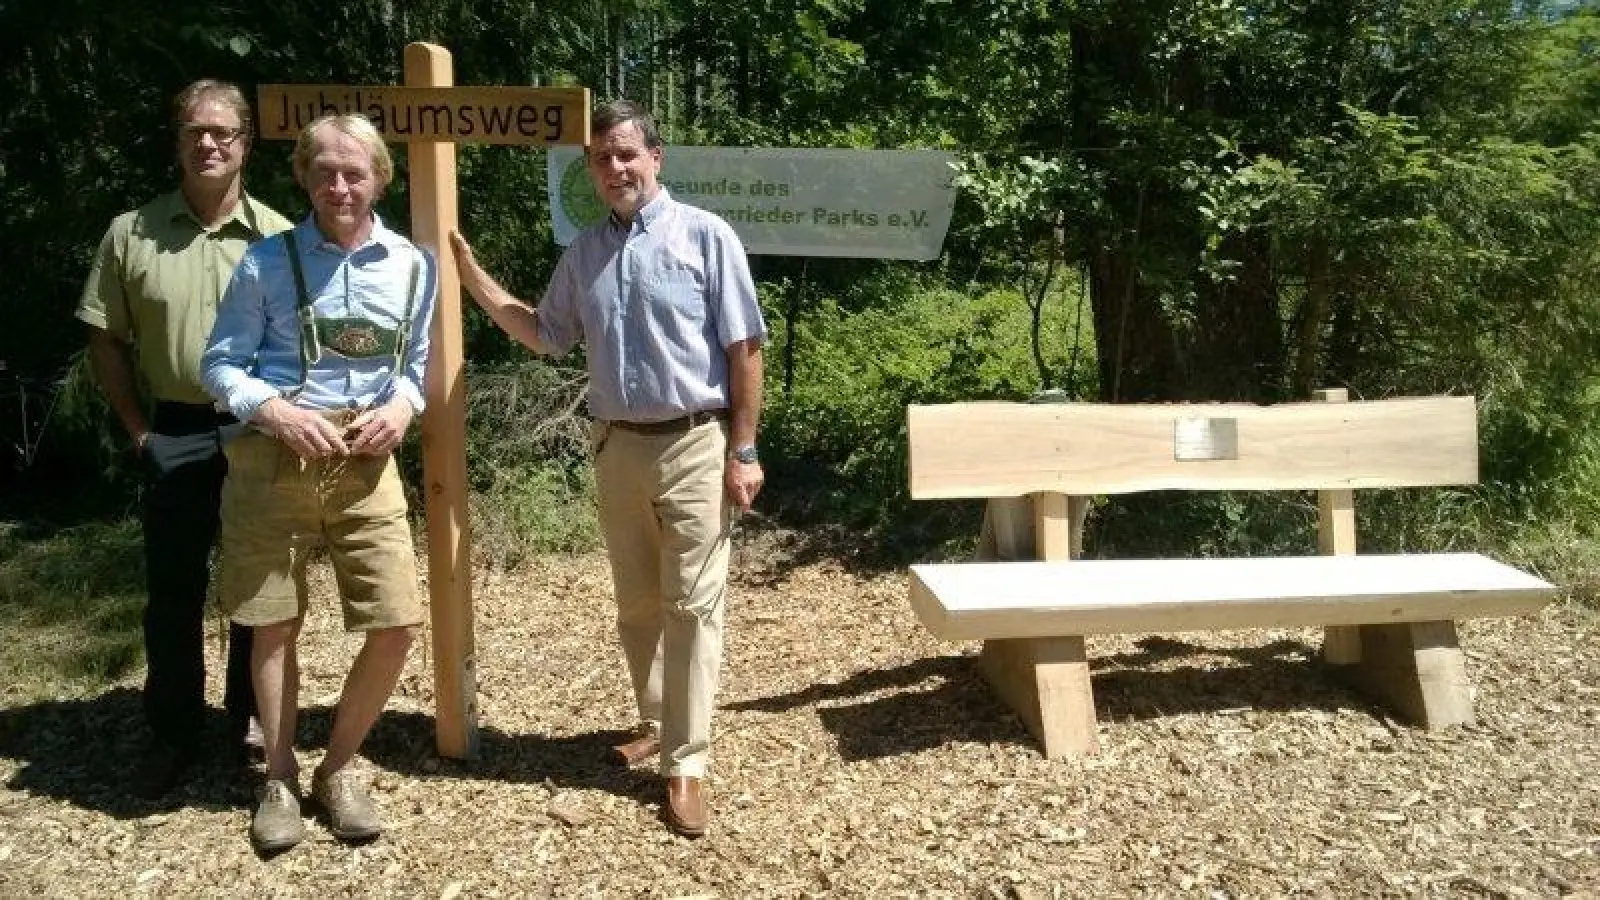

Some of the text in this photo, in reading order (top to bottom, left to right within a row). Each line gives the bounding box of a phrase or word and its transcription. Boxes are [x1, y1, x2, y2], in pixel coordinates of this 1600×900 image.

[749, 180, 789, 196] des
[813, 207, 879, 227] Parks
[887, 209, 929, 228] e.V.
